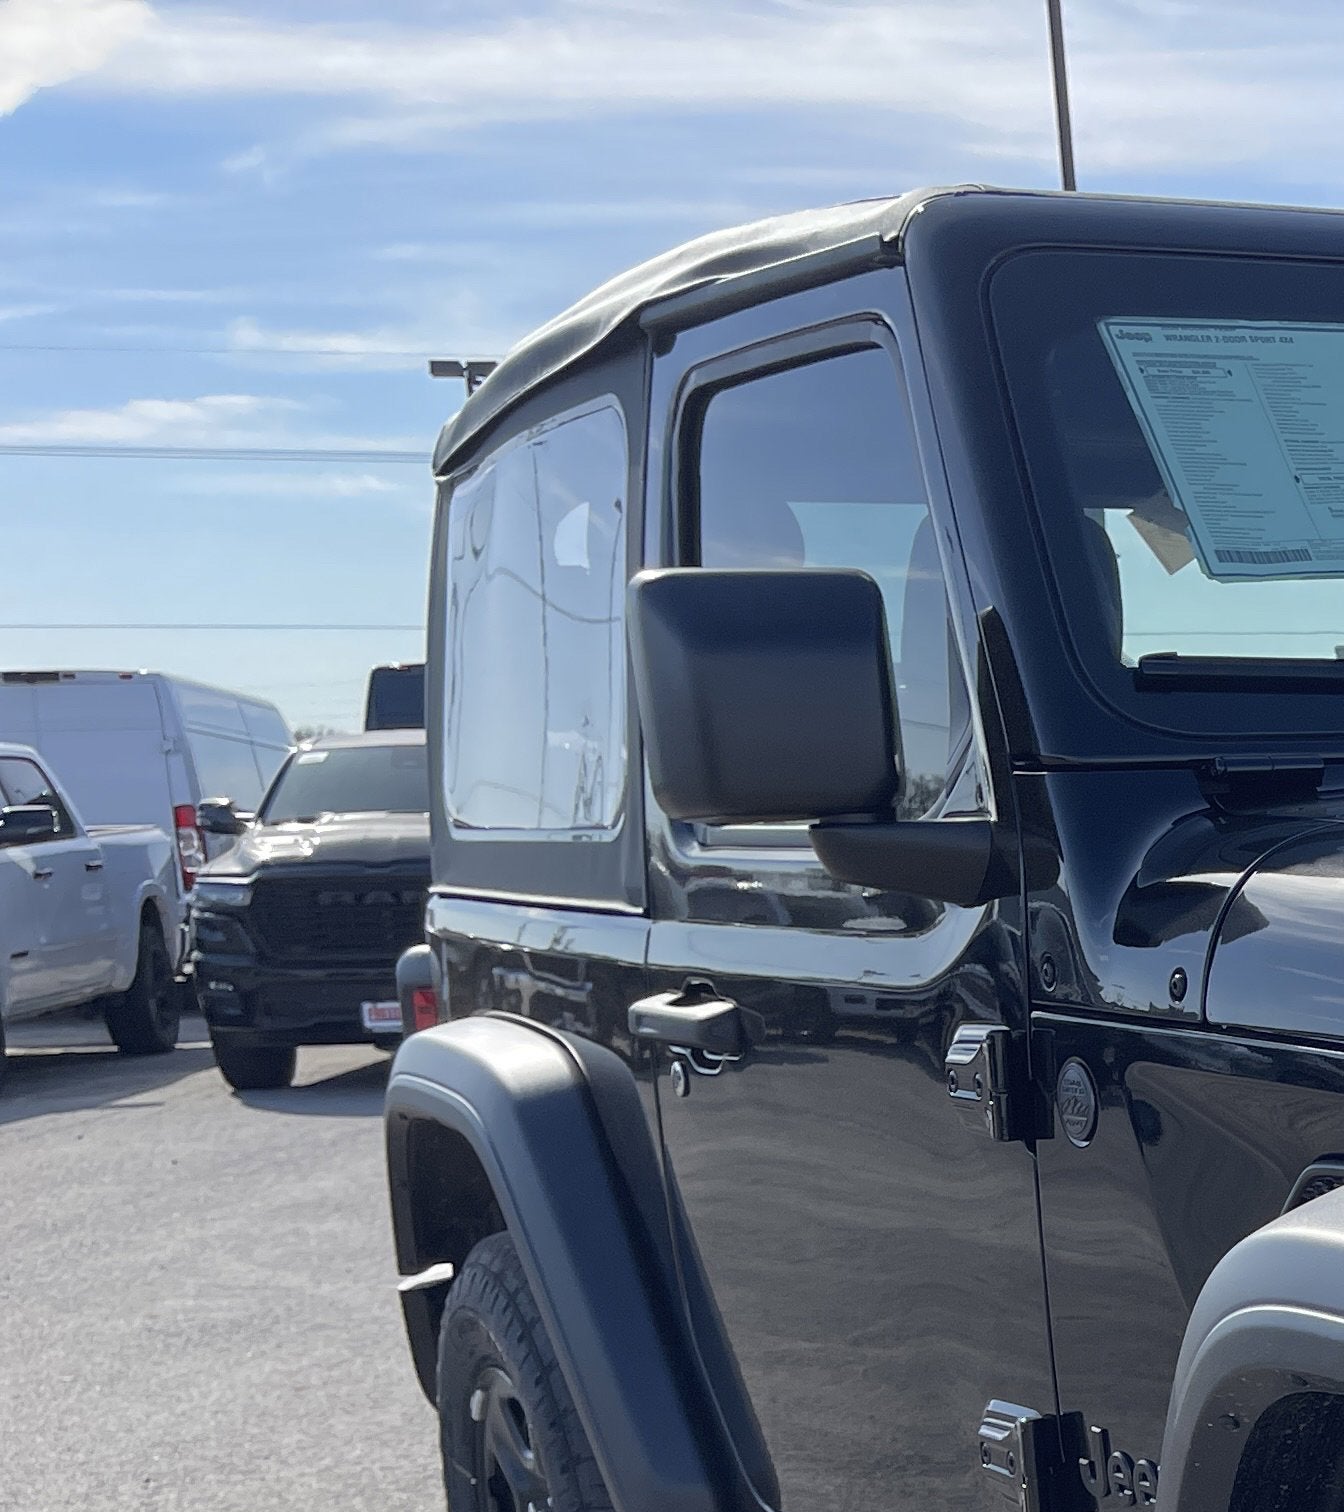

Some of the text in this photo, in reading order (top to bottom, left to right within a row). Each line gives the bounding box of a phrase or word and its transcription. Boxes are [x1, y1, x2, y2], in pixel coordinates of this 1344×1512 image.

[1115, 329, 1153, 343] Jeep
[1163, 333, 1213, 343] WRANGLER
[1214, 334, 1248, 344] 2-DOOR
[1249, 335, 1277, 344] SPORT
[1079, 1425, 1161, 1506] Jee
